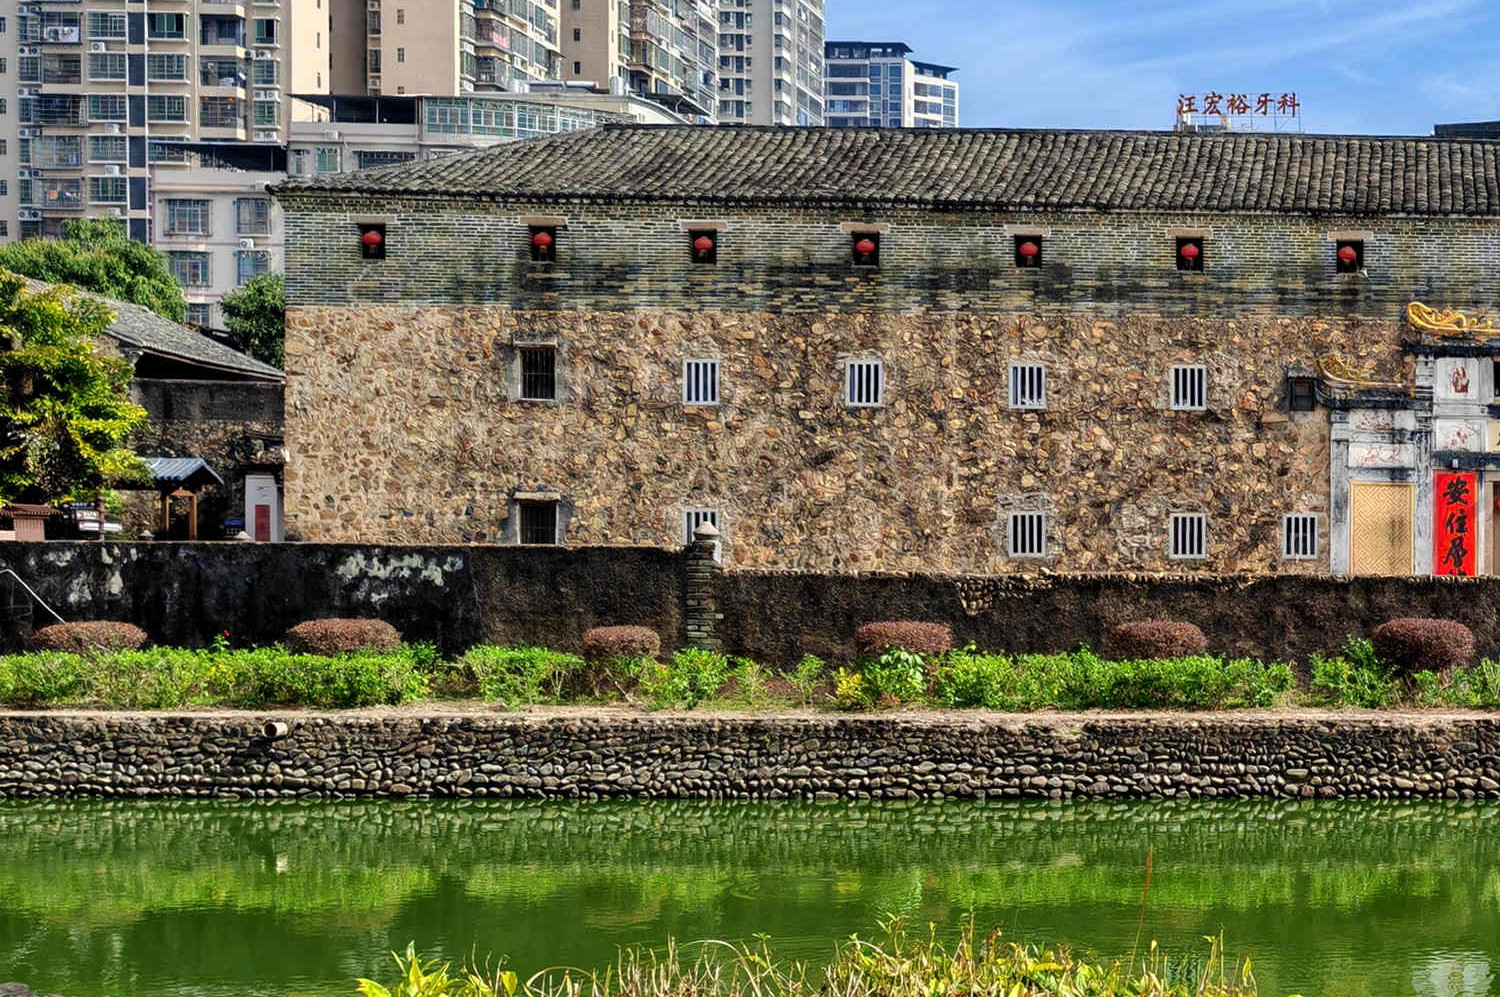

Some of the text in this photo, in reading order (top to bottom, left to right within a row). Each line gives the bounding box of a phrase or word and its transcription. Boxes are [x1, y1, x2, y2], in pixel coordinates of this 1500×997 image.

[1177, 91, 1300, 118] 汪宏裕牙科
